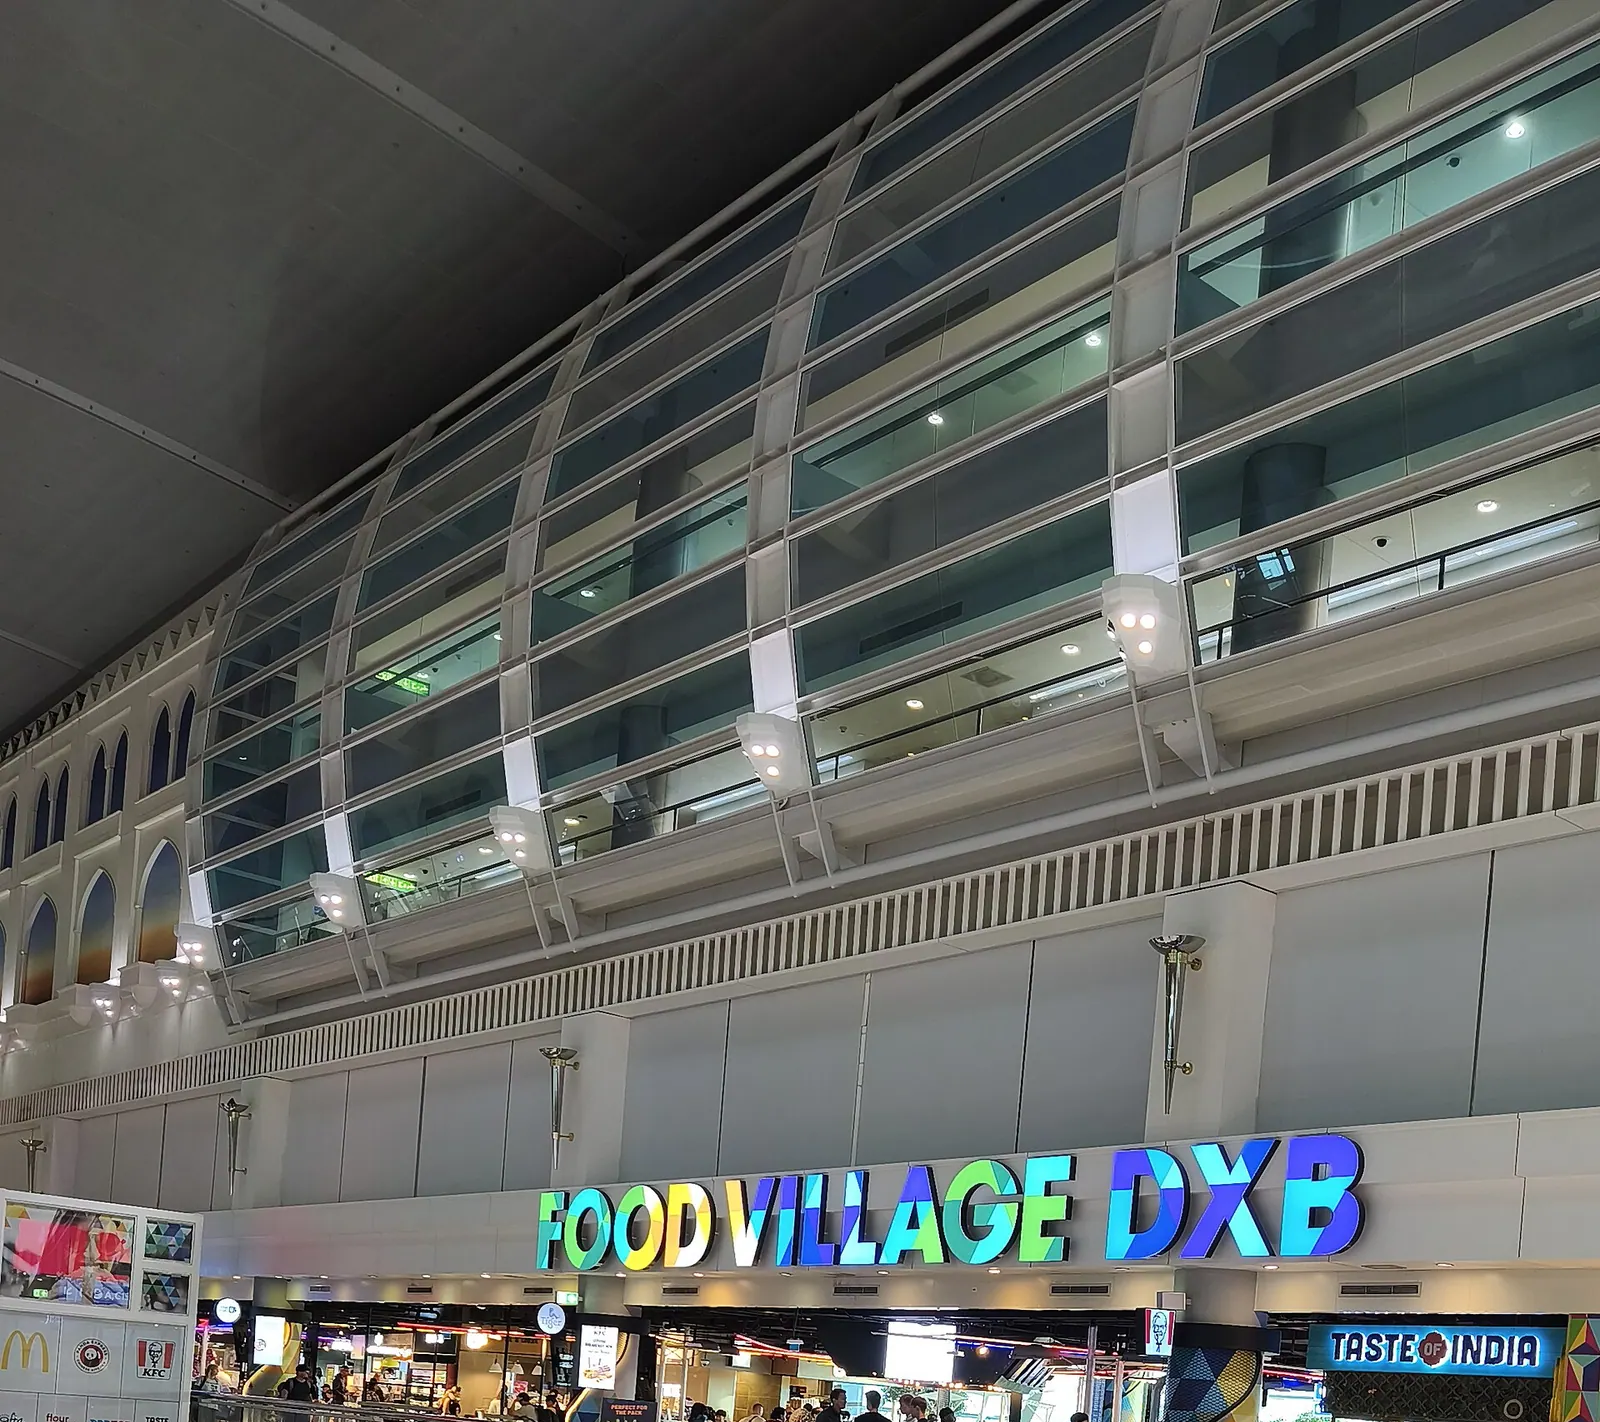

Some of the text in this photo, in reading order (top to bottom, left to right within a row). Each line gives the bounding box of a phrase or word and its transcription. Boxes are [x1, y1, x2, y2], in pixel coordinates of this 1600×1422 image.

[536, 1134, 1365, 1271] FOOD VILLAGE DXB
[1331, 1332, 1416, 1362] TASTE
[1424, 1342, 1442, 1356] OF
[1452, 1334, 1538, 1366] INDIA
[142, 1368, 166, 1378] KFC
[46, 1413, 69, 1422] flour
